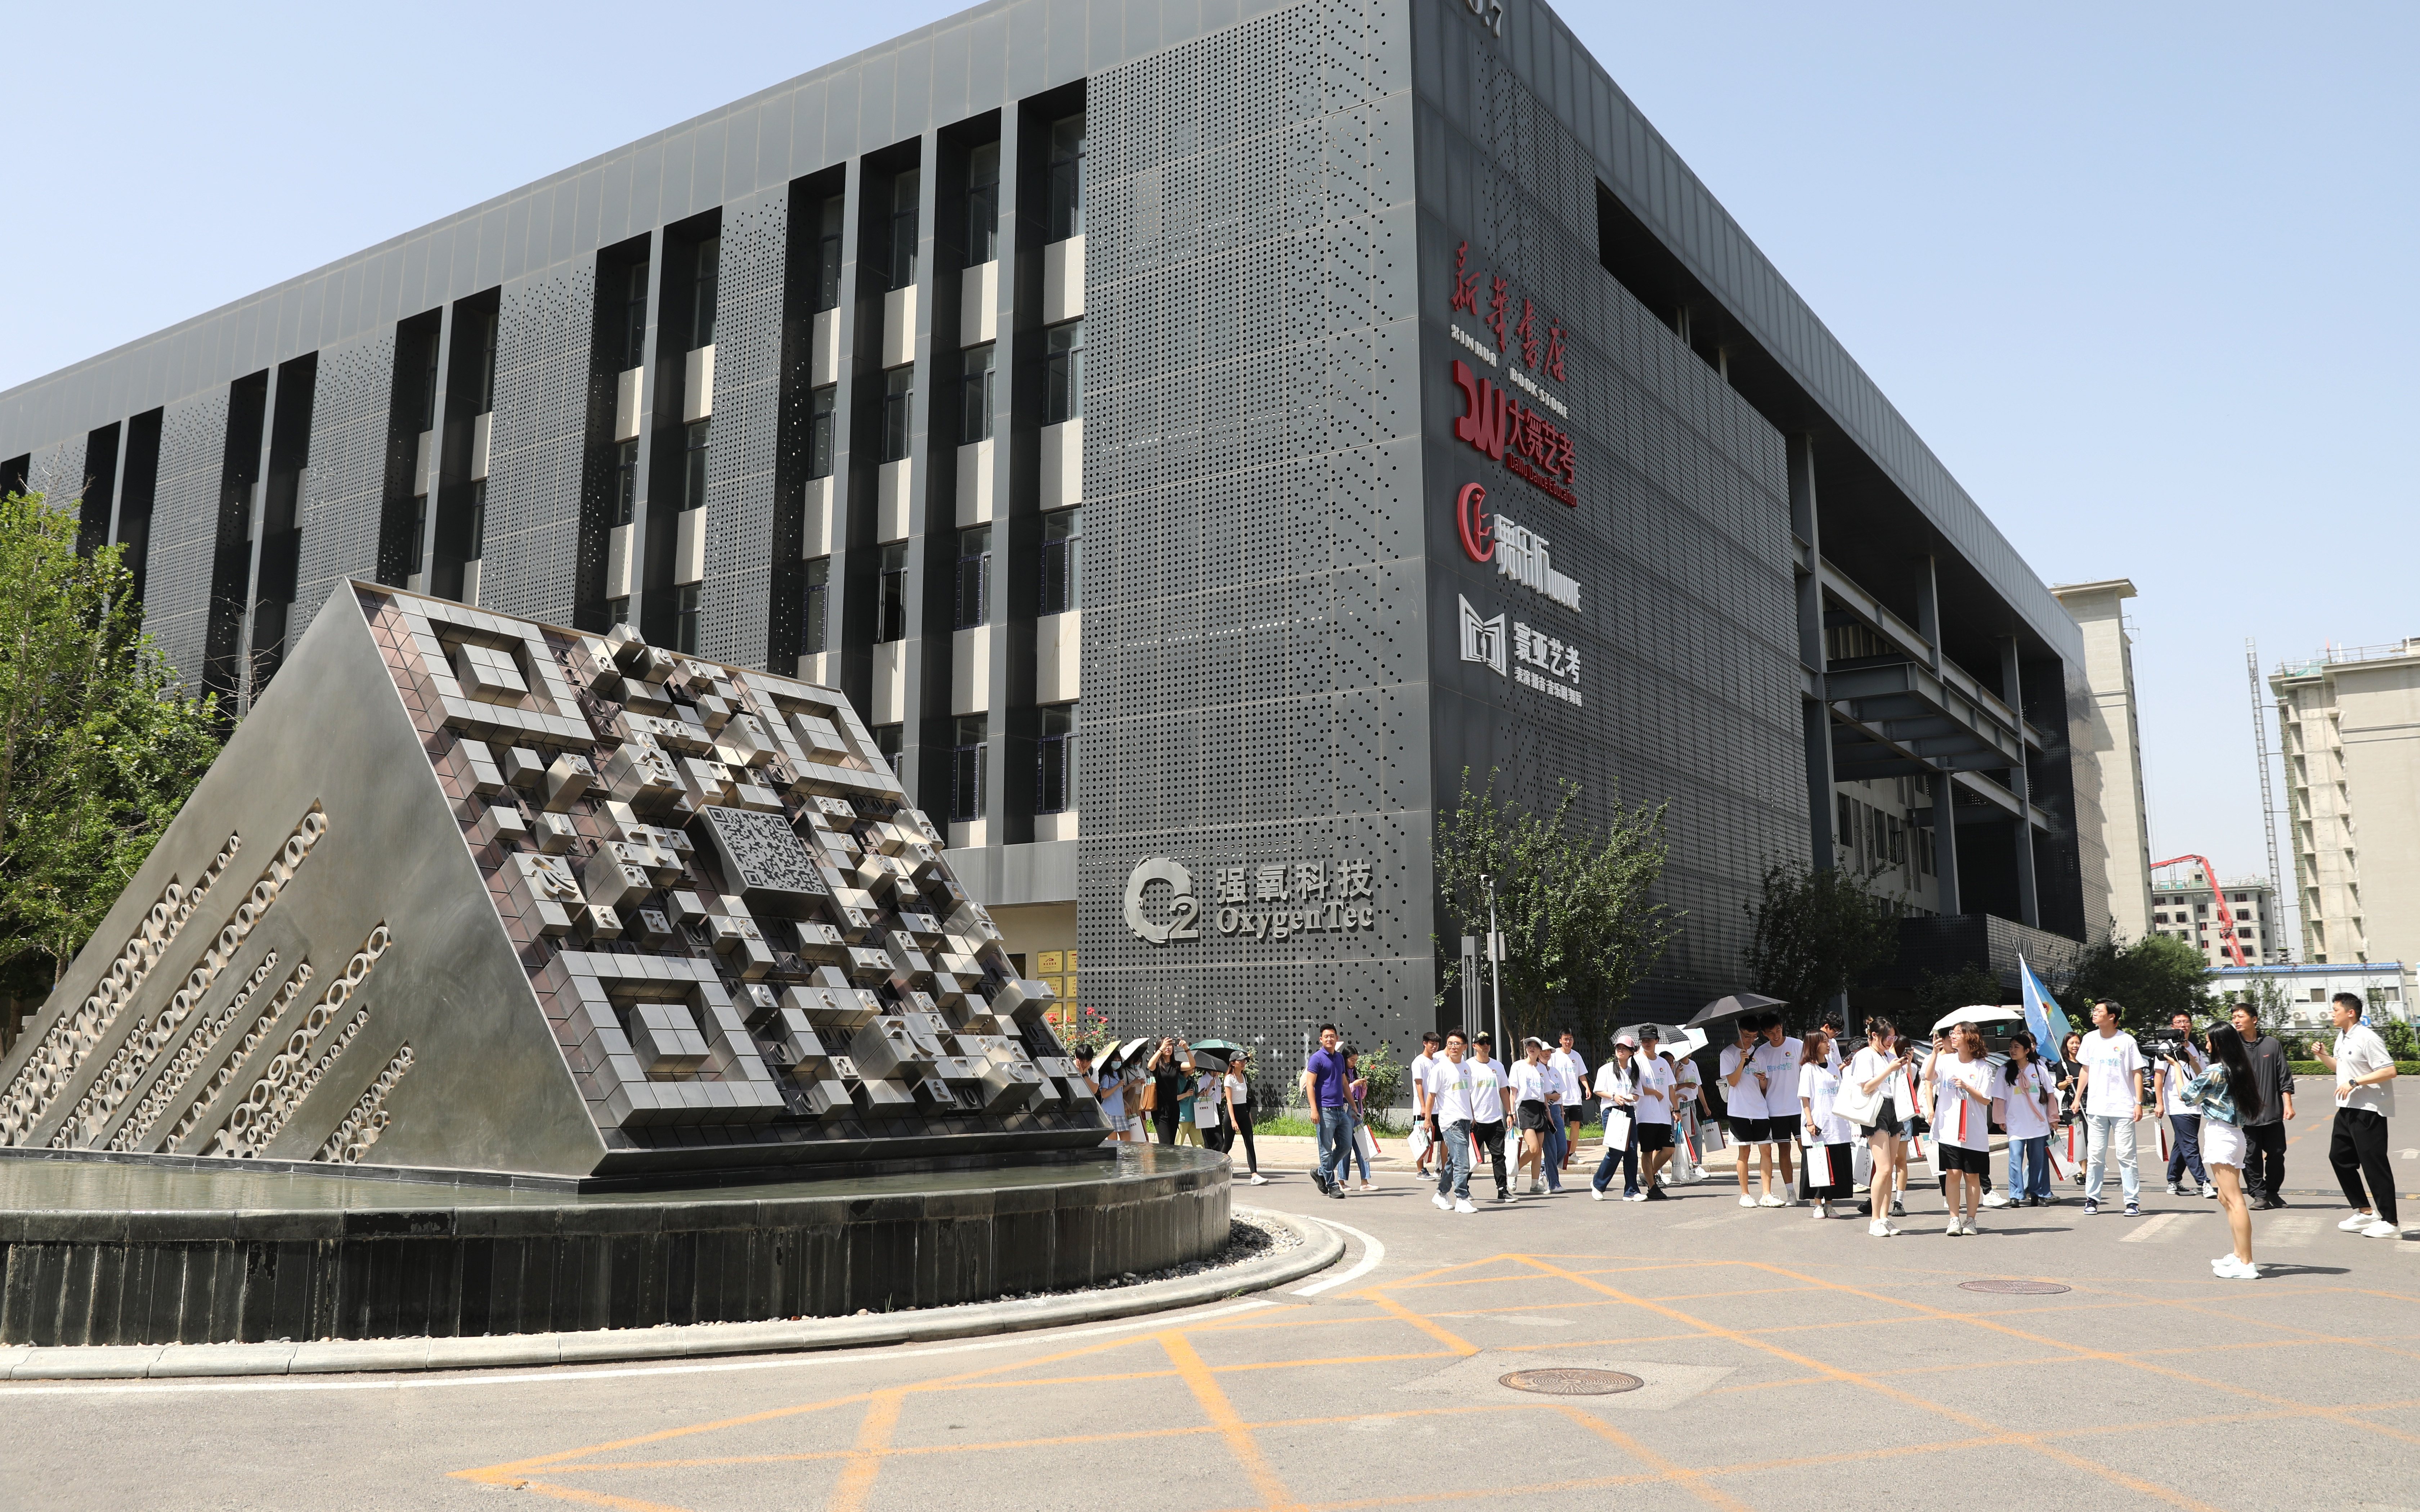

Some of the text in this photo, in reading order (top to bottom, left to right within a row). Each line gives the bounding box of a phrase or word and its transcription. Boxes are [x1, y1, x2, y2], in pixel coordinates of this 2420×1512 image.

[1451, 324, 1497, 368] XINHUA
[1509, 367, 1569, 420] BOOK STORE
[1529, 464, 1548, 489] Dance
[1548, 477, 1577, 507] Education
[1216, 858, 1373, 904] 强氧科技
[1216, 901, 1374, 939] OxygenTec
